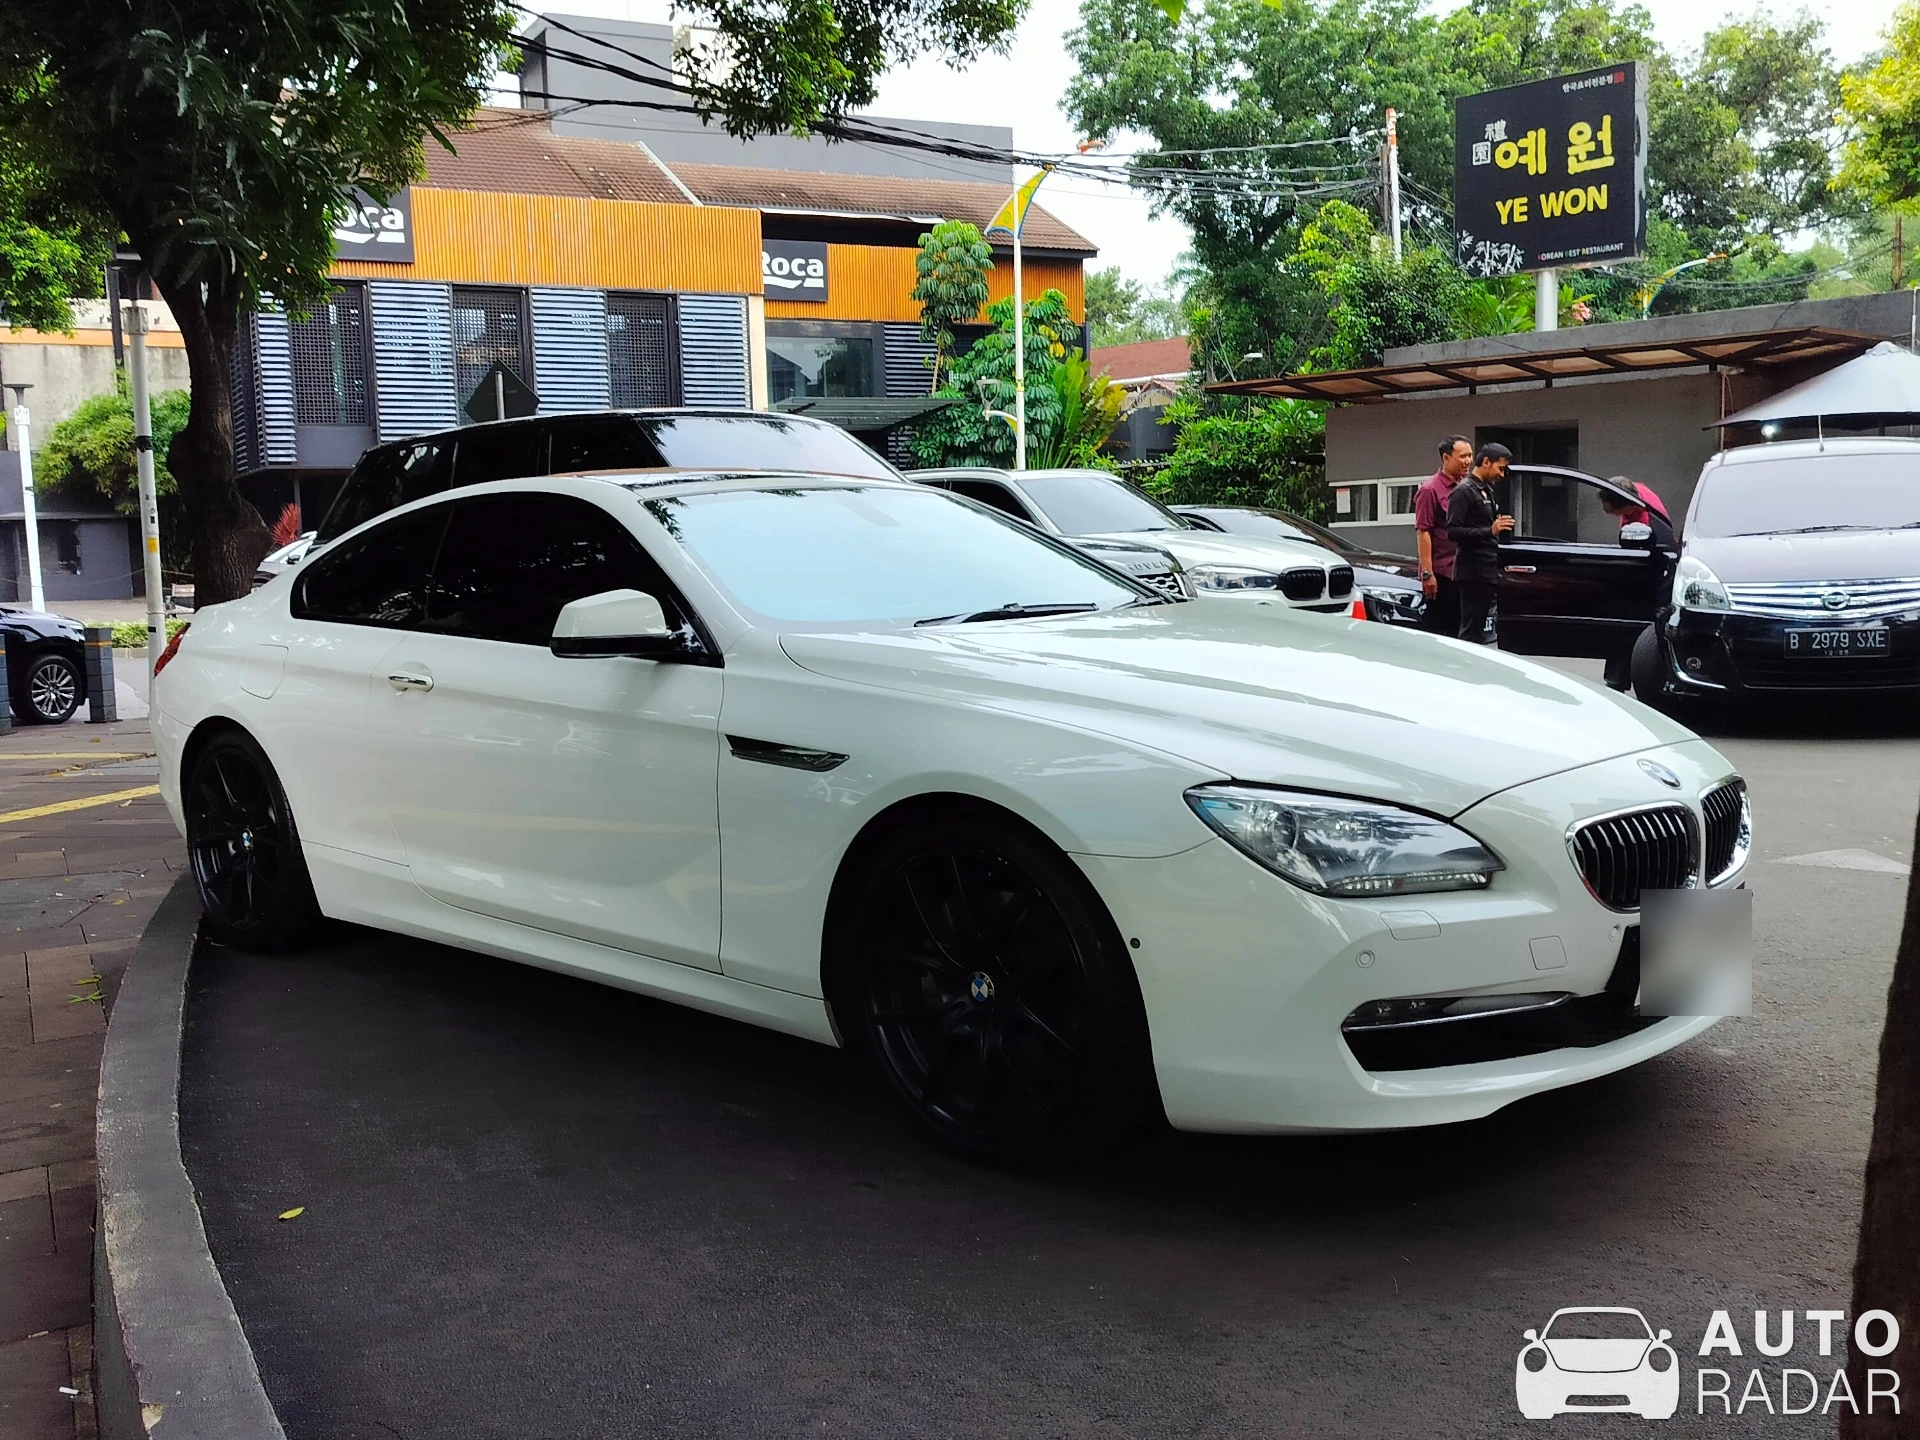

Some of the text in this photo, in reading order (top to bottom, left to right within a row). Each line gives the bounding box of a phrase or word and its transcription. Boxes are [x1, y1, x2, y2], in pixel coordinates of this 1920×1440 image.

[326, 204, 404, 230] oca
[1495, 184, 1607, 225] YE WON
[1790, 630, 1886, 649] B 2979 SXE
